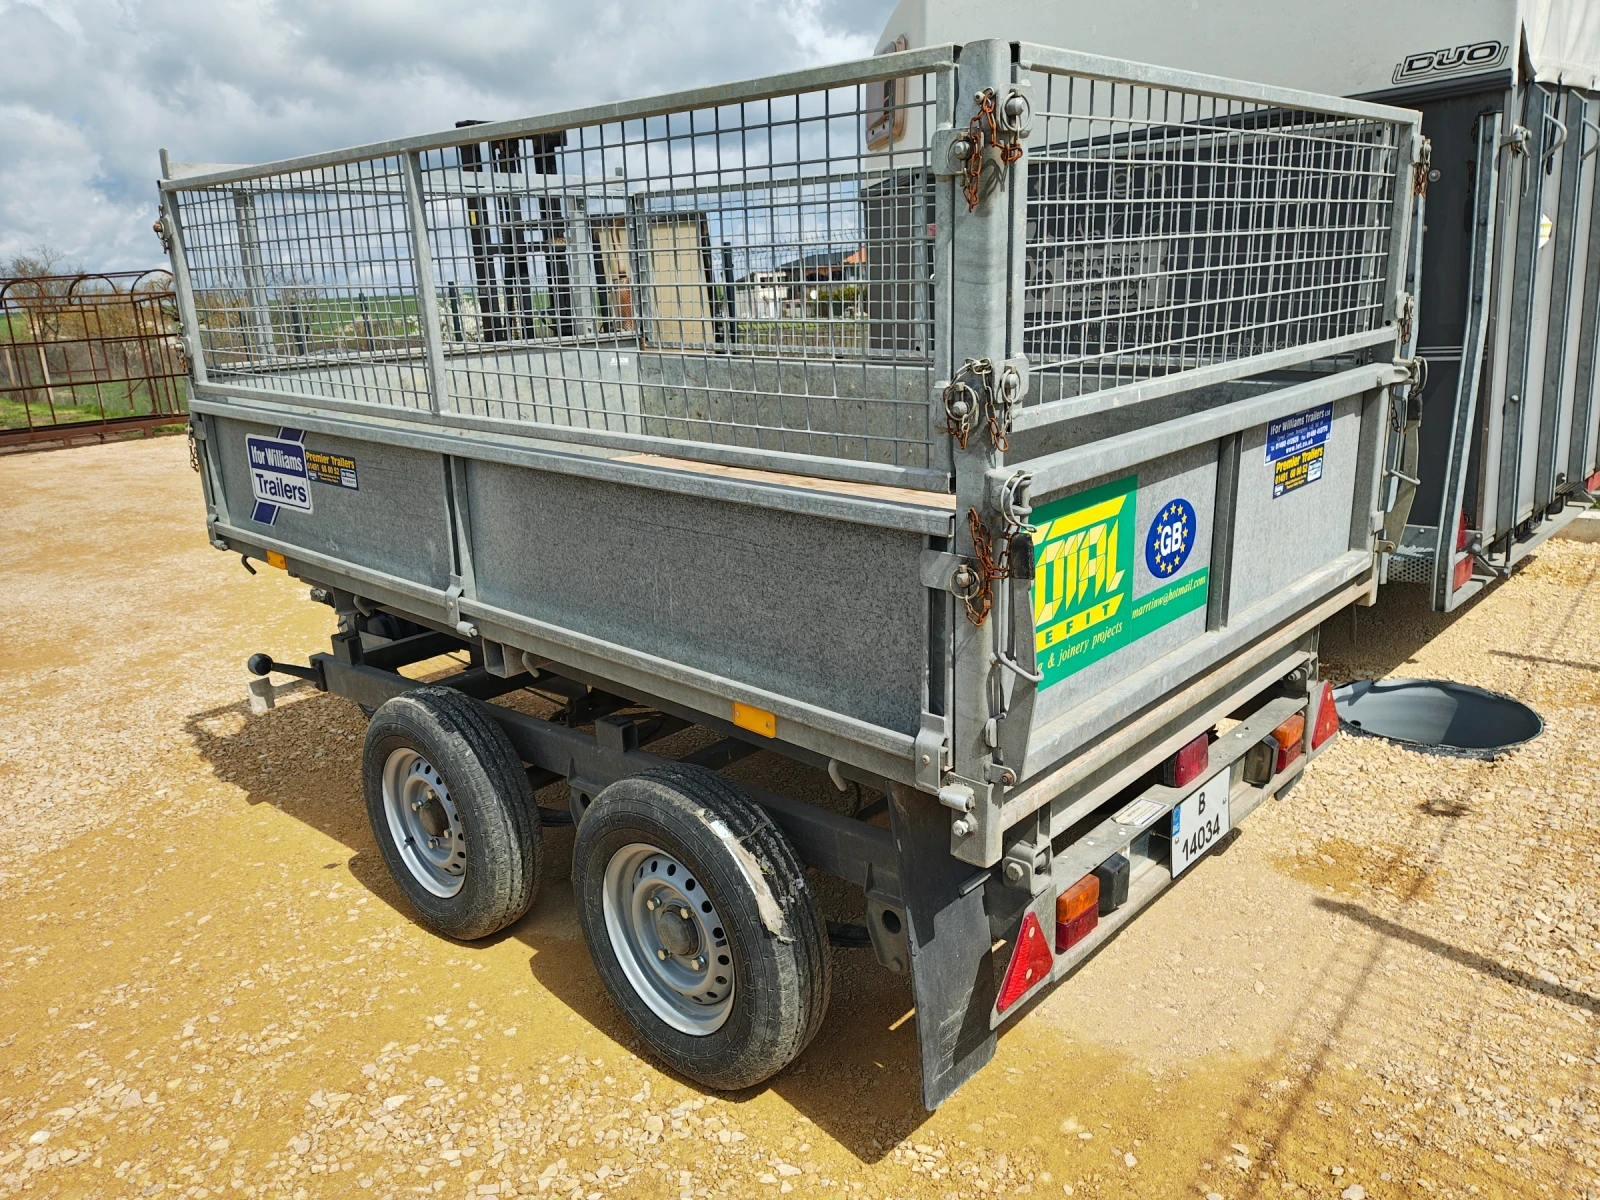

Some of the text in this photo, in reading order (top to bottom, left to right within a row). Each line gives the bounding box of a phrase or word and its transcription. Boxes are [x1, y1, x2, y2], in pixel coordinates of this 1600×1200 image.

[1400, 40, 1502, 77] DUO
[1282, 416, 1305, 431] Williams
[1305, 408, 1325, 423] Trailers
[250, 445, 303, 472] Ifor Williams
[305, 451, 355, 470] Premier Trailers
[1275, 455, 1301, 474] Premier
[1301, 446, 1324, 464] Trailers
[254, 473, 307, 503] Trailers
[1160, 521, 1184, 557] GB
[1047, 622, 1123, 669] & joinery projects
[1198, 791, 1206, 817] B
[1182, 812, 1221, 862] 14034
